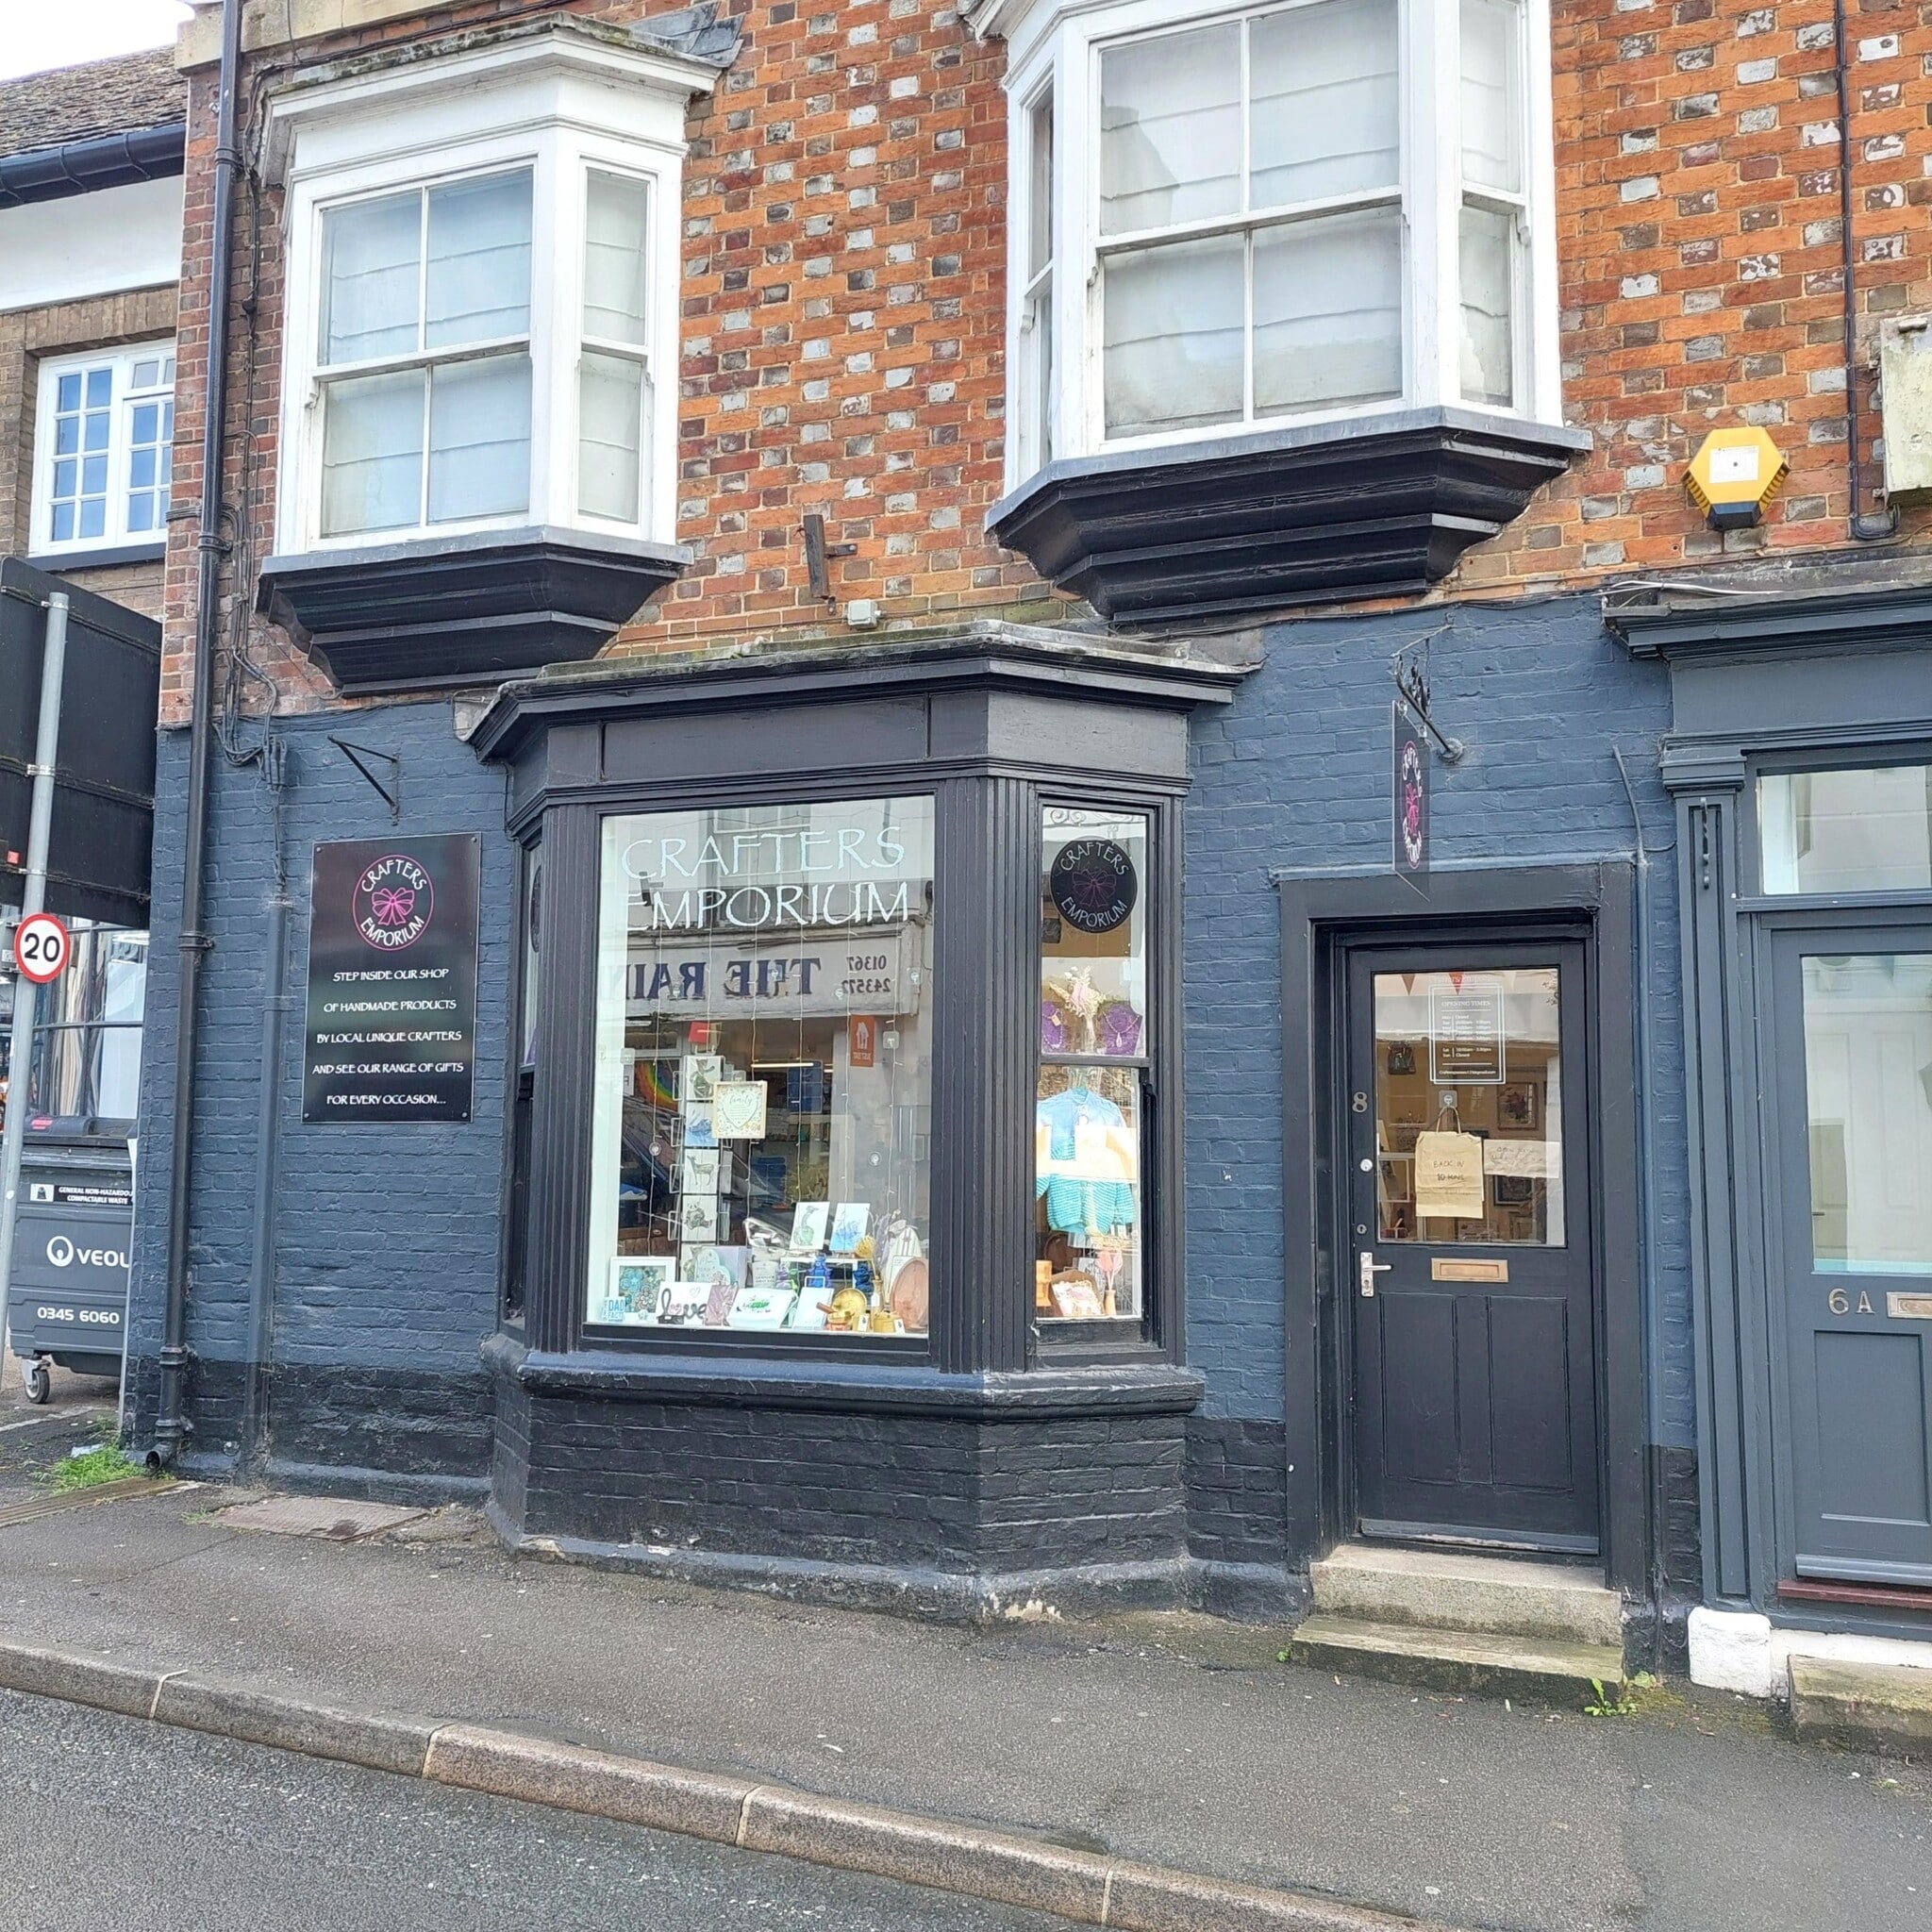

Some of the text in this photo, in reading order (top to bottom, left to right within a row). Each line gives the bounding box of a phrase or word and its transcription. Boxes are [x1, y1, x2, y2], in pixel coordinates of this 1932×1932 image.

[622, 826, 905, 879] CRAFTERS
[1060, 841, 1129, 875] CRAFTERS
[361, 858, 427, 892] CRAFTERS
[1061, 896, 1128, 927] EMPORIUM
[360, 914, 425, 946] EMPORIUM
[25, 932, 60, 962] 20
[332, 968, 449, 982] STEP INSIDE OUR SHOP
[324, 1000, 457, 1012] OF HANDMADE PRODUCTS
[317, 1030, 462, 1043] BY LOCAL UNIQUE CRAFTERS
[312, 1062, 464, 1074] AND SEE OUR RANGE OF GIFTS
[326, 1094, 446, 1105] FOR EVERY OCCASION...
[1352, 1091, 1368, 1113] 8
[58, 1186, 84, 1194] GENERAL
[67, 1194, 108, 1204] COMPACTABLE
[37, 1307, 120, 1324] 0345 6060
